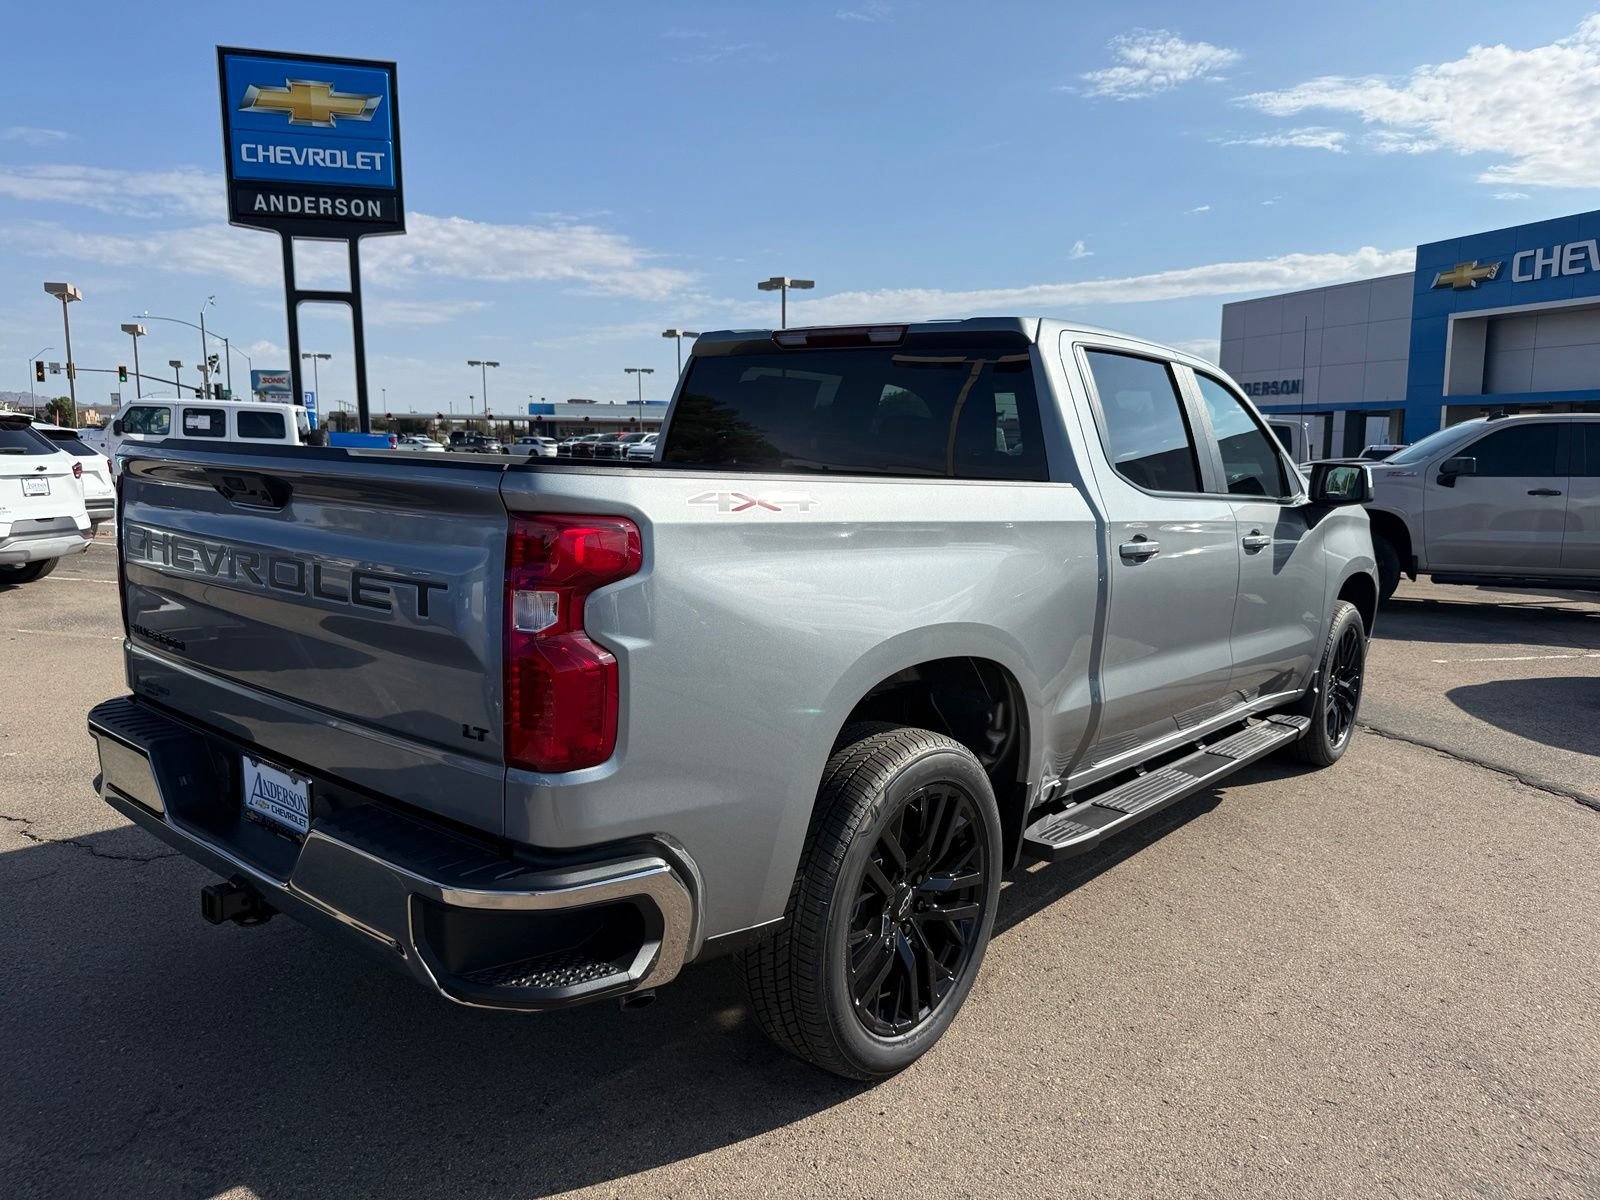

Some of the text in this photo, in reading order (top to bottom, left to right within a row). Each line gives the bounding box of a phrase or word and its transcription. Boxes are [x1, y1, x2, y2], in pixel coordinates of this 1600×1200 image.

[241, 143, 385, 171] CHEVROLET
[253, 193, 382, 217] ANDERSON
[1239, 379, 1301, 396] DERSON
[126, 525, 448, 619] CHEVROLET
[462, 724, 489, 742] LT
[248, 772, 308, 814] ANDERSON
[271, 804, 307, 828] CHEVROLET
